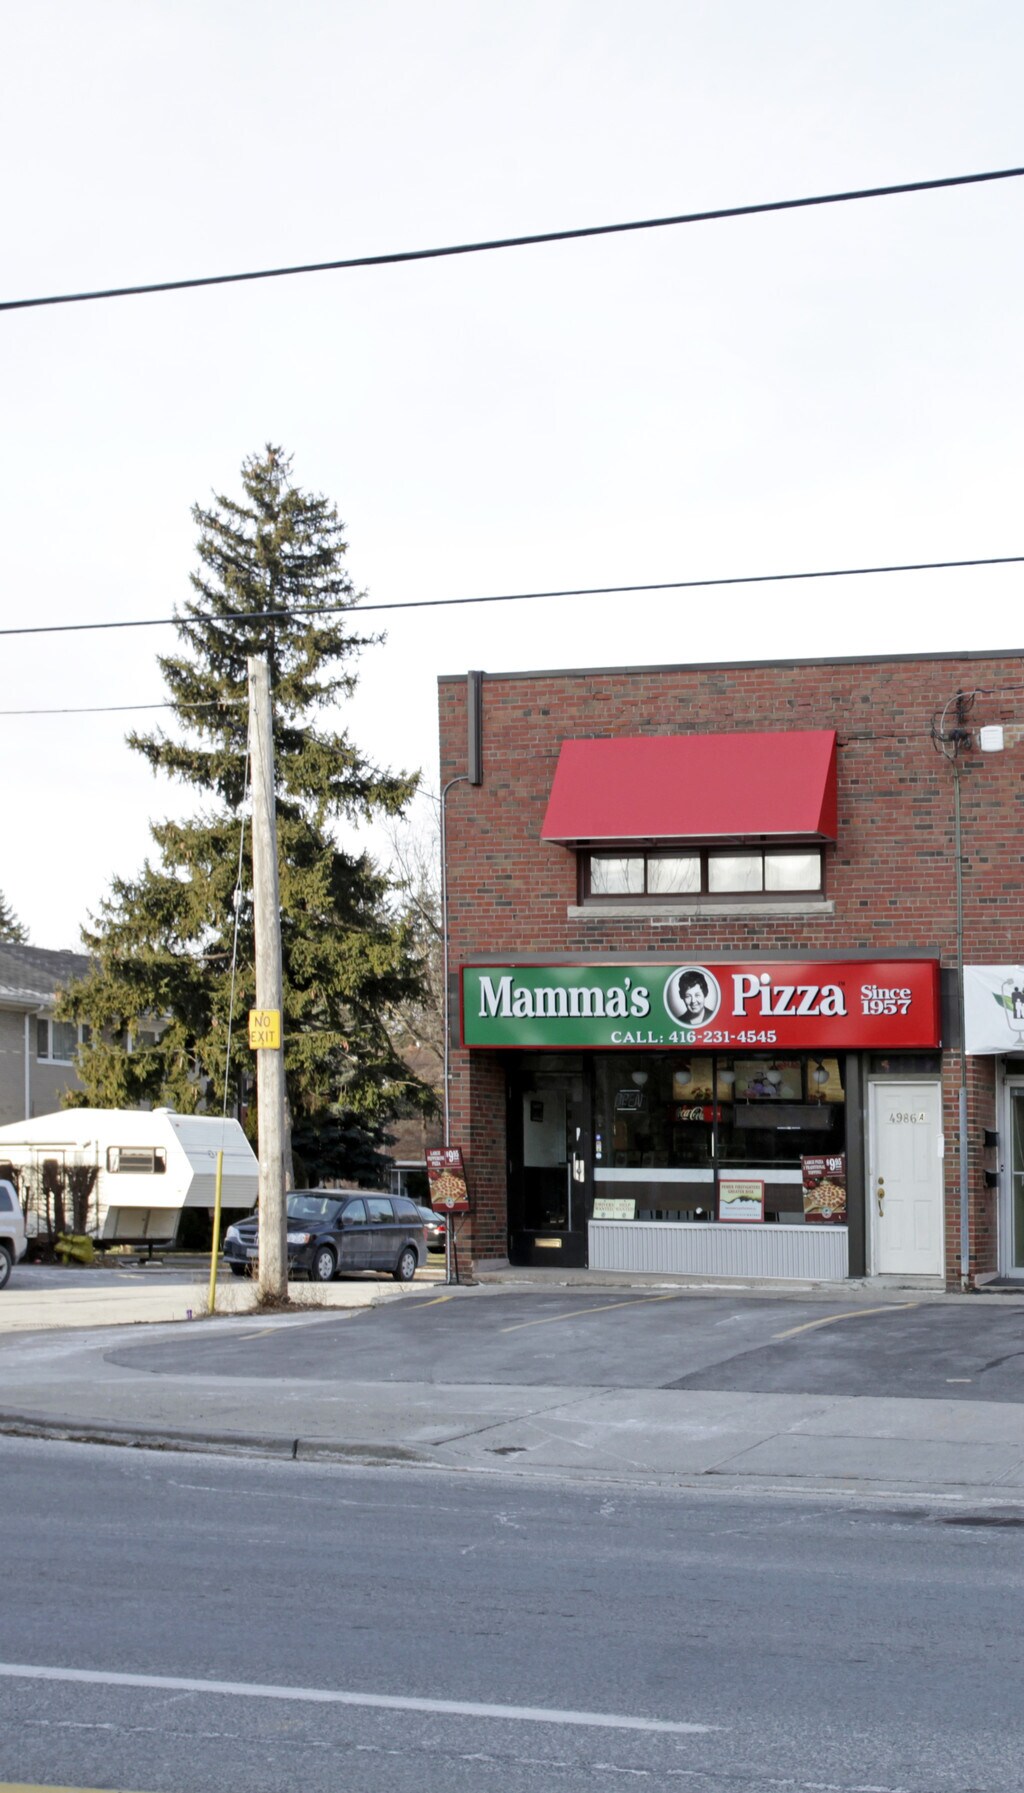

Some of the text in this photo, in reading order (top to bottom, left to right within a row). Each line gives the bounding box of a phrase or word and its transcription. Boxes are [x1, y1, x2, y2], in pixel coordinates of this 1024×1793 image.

[478, 975, 650, 1017] Mamma's
[732, 973, 847, 1016] Pizza
[860, 985, 912, 1001] Since
[861, 1000, 912, 1015] 1957
[254, 1015, 271, 1028] NO
[250, 1030, 276, 1043] EXIT
[610, 1030, 778, 1044] CALL: 416-231-4545
